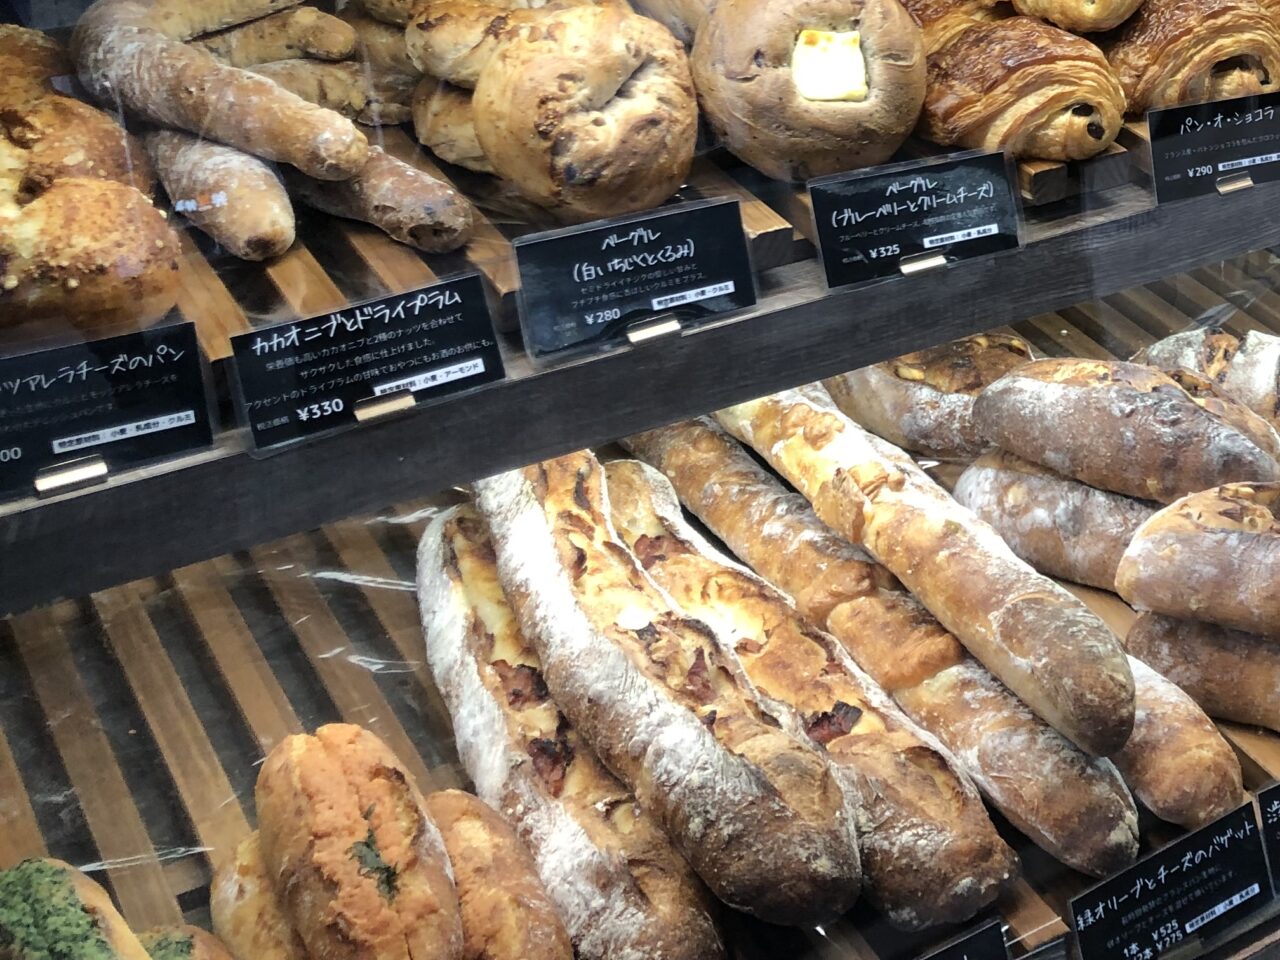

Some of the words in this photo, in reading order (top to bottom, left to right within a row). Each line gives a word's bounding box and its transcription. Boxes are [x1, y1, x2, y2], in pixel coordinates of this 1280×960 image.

[1180, 105, 1275, 136] パン・オ・ショコラ
[1187, 163, 1214, 178] ¥290
[885, 176, 939, 197] ベーグル
[600, 226, 663, 251] ベーグル
[867, 243, 901, 260] ¥325
[252, 290, 463, 357] カカオニブとドライプラム
[584, 307, 622, 326] ¥280
[296, 397, 345, 422] ¥330
[1076, 821, 1256, 933] 緑オリーブとチーズのバゲット
[1151, 920, 1181, 942] ¥525
